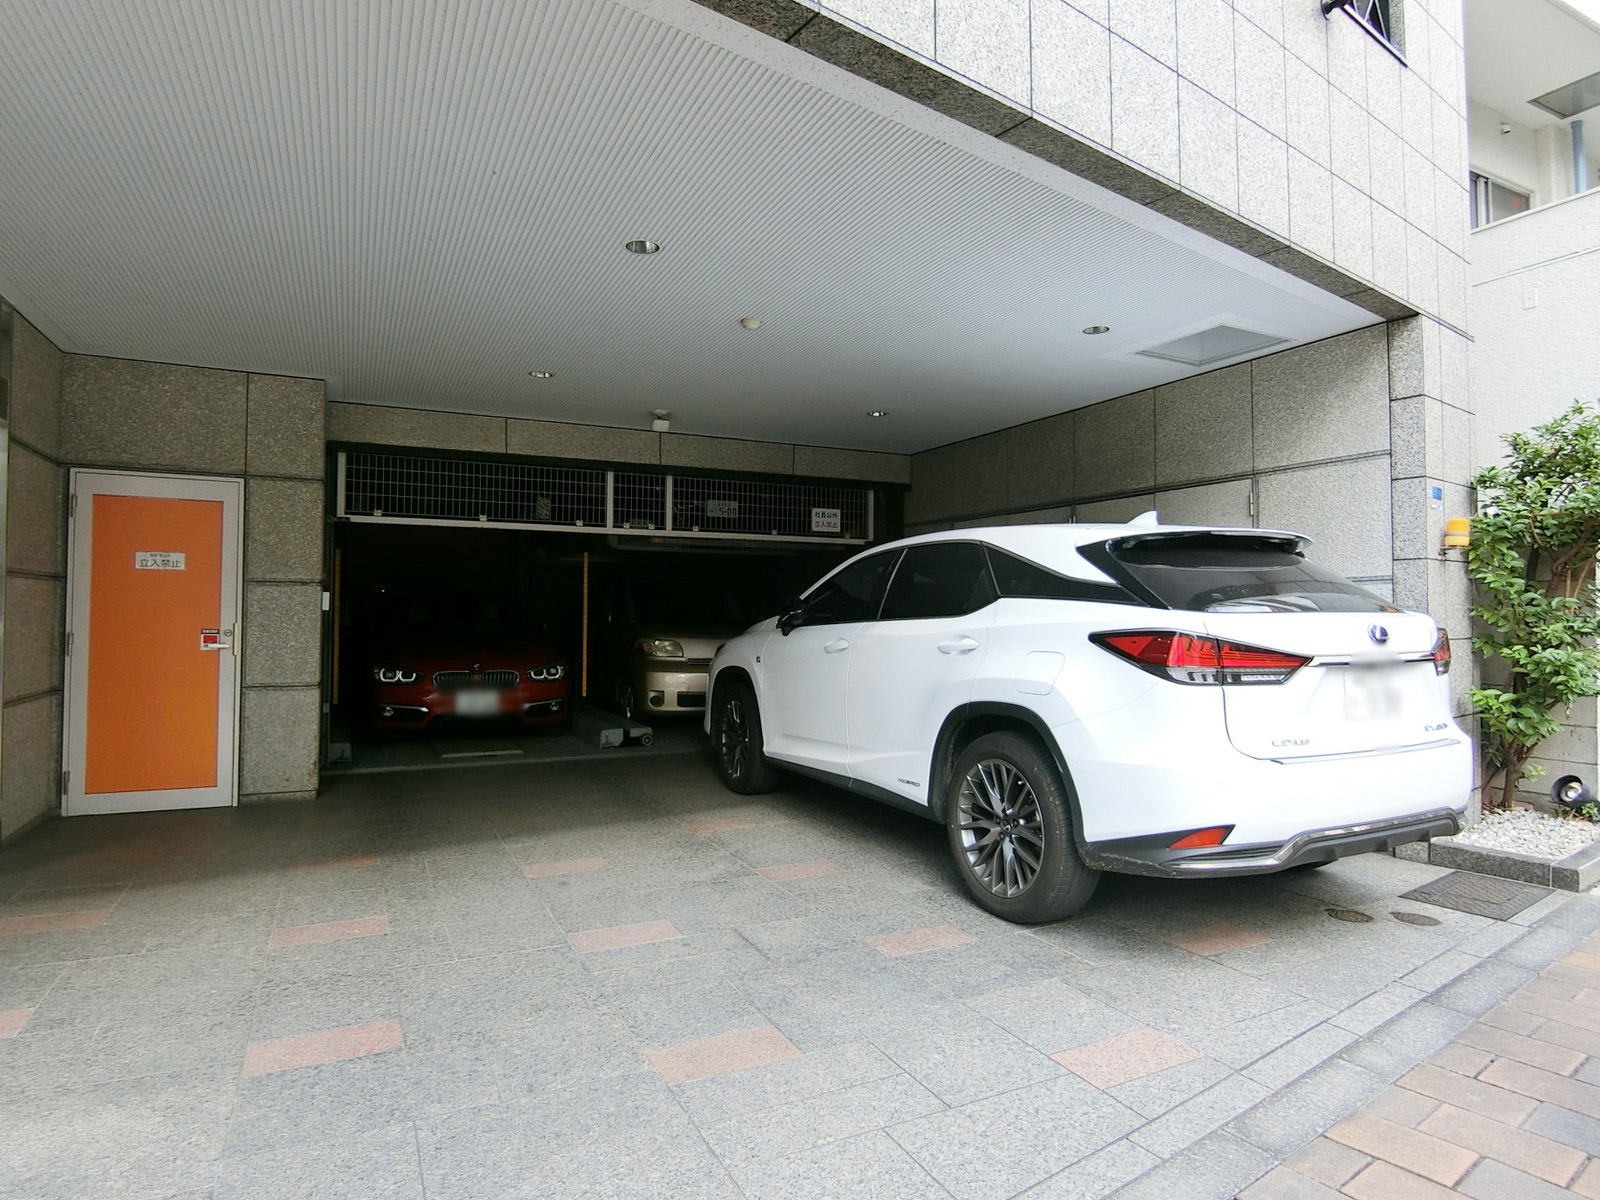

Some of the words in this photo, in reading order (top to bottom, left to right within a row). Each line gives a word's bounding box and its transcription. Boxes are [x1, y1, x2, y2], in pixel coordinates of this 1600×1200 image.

[814, 520, 839, 529] 立入禁止
[139, 559, 182, 568] 立入禁止
